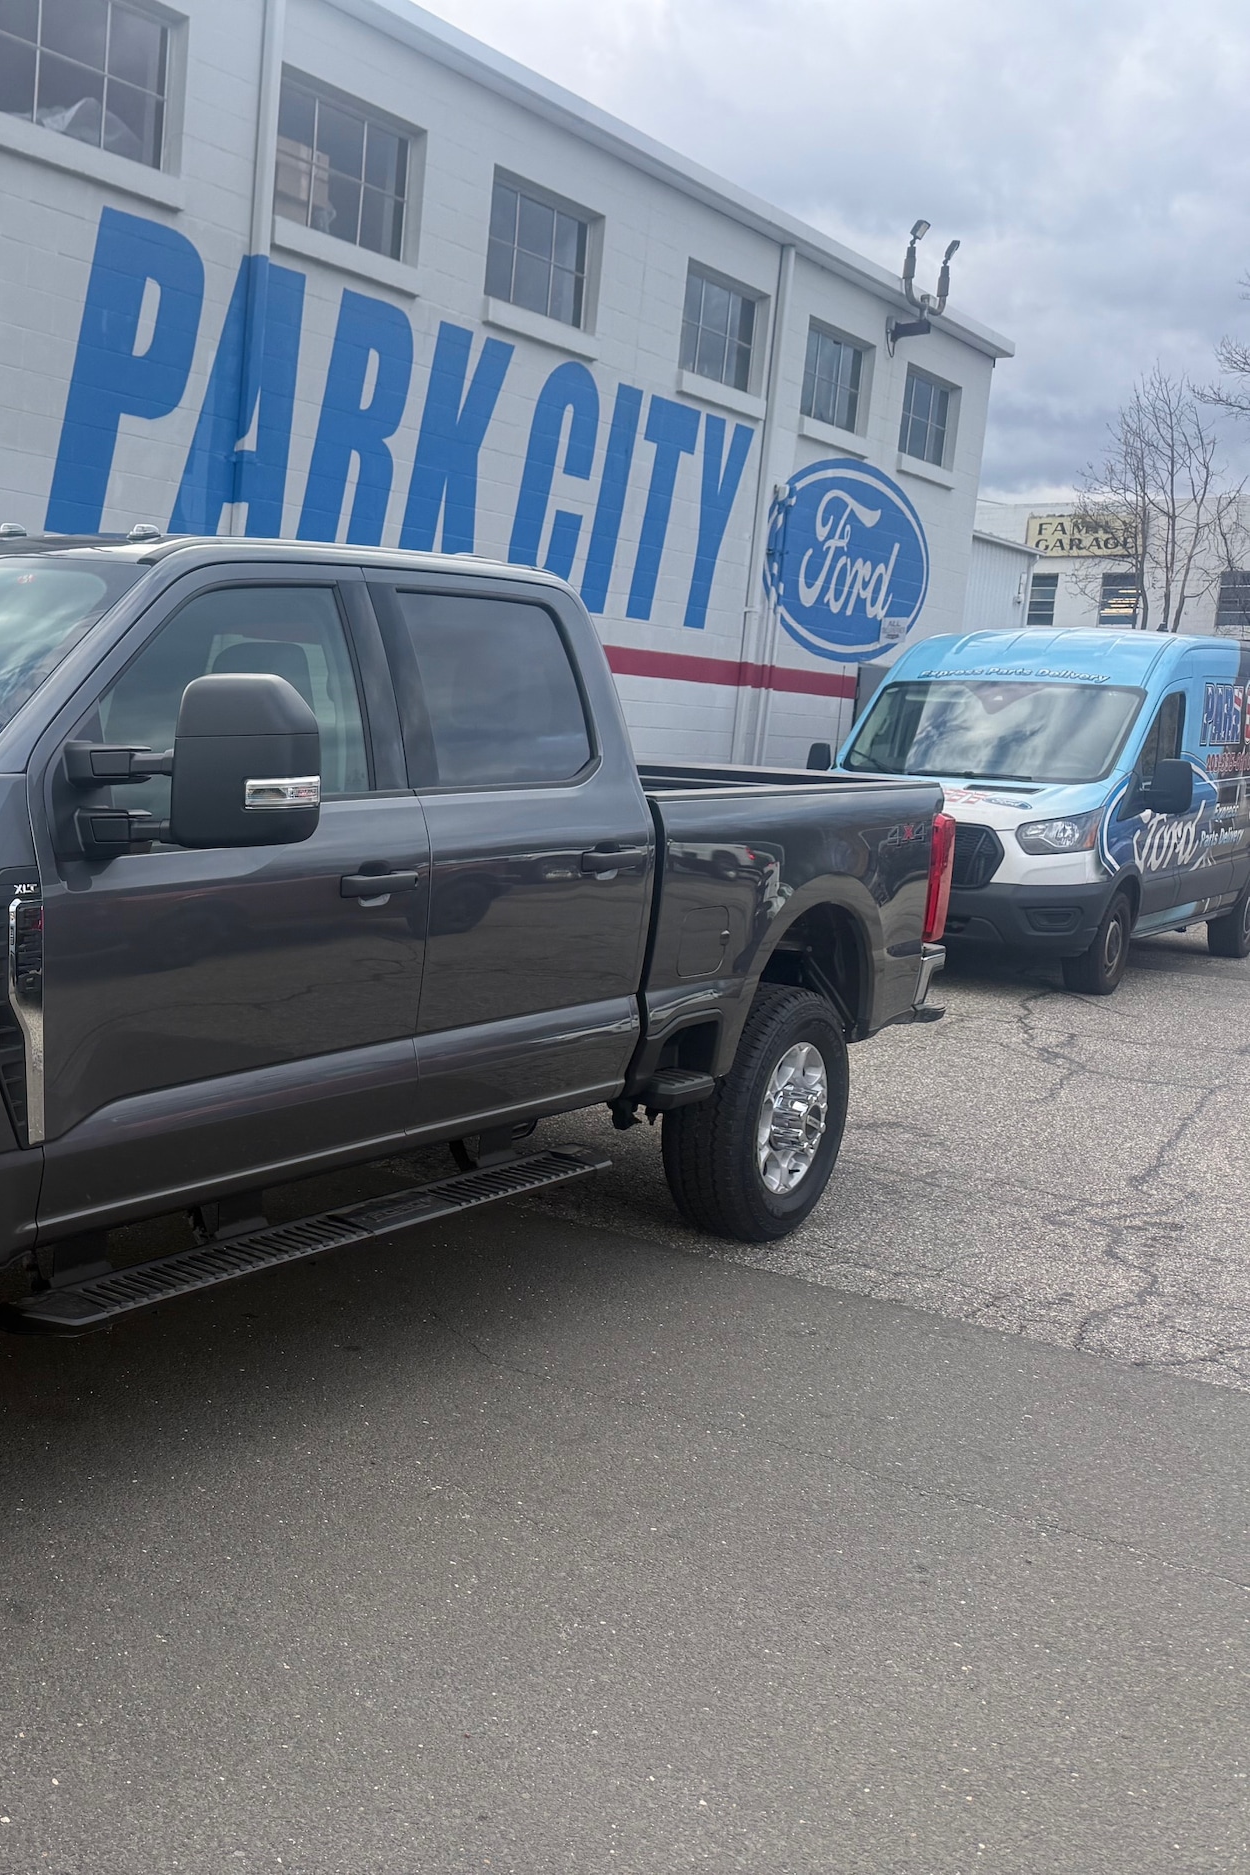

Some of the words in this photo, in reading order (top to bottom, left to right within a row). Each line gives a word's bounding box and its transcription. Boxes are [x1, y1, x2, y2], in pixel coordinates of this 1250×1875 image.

[44, 206, 515, 553] PARK
[507, 361, 755, 630] CITY
[799, 489, 899, 620] Ford
[918, 667, 984, 679] Express
[985, 667, 1032, 677] Parts
[1034, 668, 1111, 683] Delivery
[13, 883, 37, 895] XLT
